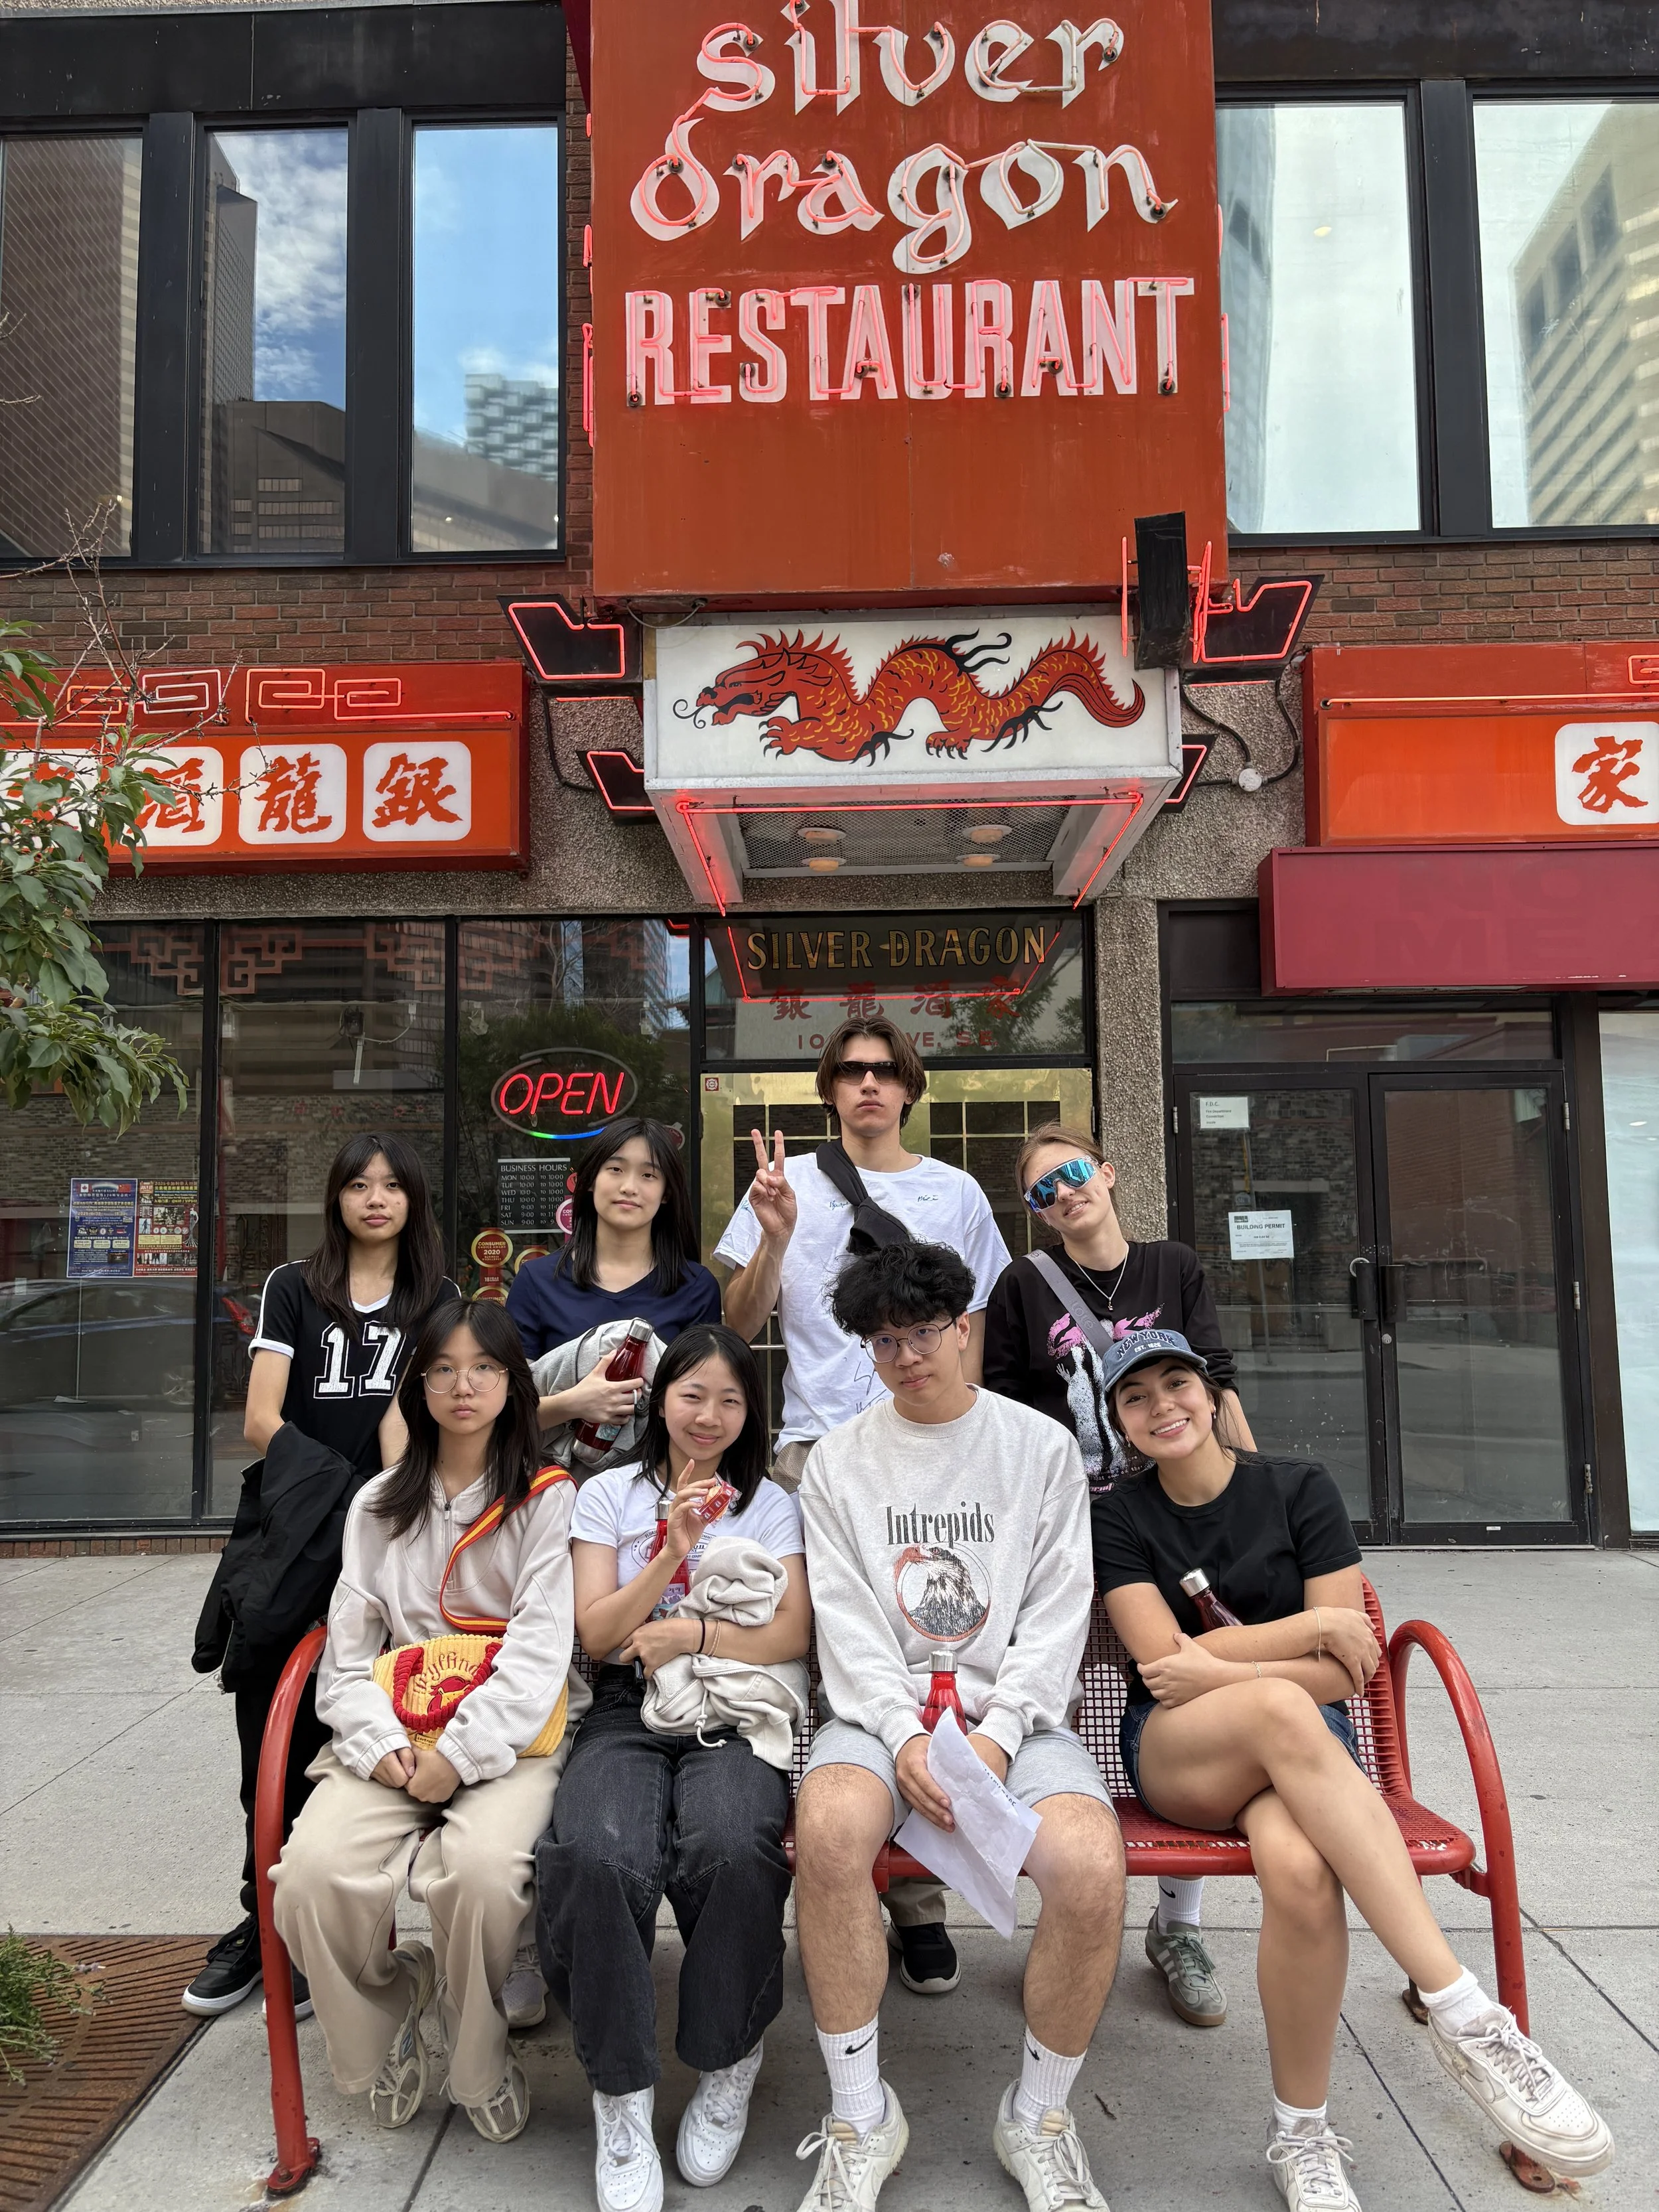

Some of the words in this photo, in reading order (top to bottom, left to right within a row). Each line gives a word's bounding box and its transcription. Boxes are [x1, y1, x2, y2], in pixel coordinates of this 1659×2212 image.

[696, 0, 1124, 116] silver
[630, 118, 1179, 273] dragon
[625, 277, 1194, 406] RESTAURANT
[747, 930, 873, 970] SILVER
[889, 926, 1046, 968] DRAGON
[499, 1072, 624, 1115] OPEN
[313, 1320, 407, 1399] 17
[1118, 1333, 1140, 1361] NEW
[1139, 1331, 1179, 1349] YORK
[885, 1501, 995, 1550] Intrepids
